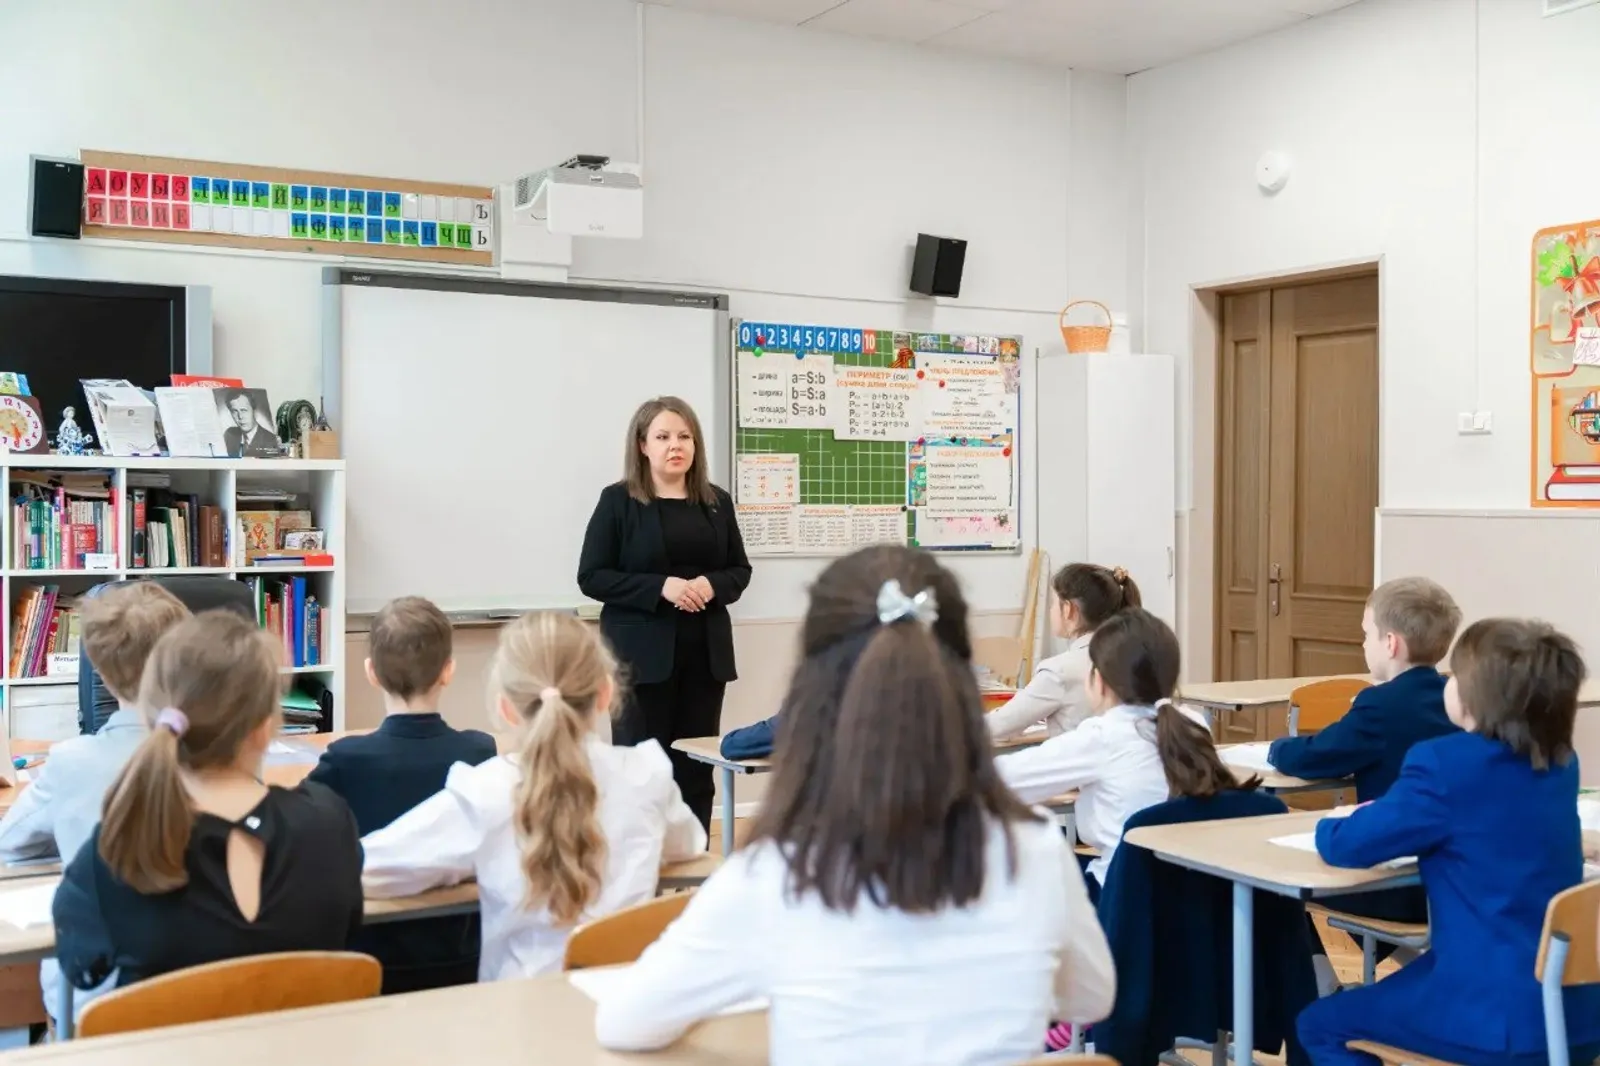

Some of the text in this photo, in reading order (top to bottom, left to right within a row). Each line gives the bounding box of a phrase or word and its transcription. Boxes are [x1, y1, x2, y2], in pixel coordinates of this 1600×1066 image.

[90, 175, 104, 193] А
[111, 176, 124, 192] О
[133, 177, 146, 193] У
[152, 178, 168, 195] Ы
[175, 180, 186, 196] Э
[214, 183, 229, 200] М
[235, 184, 248, 201] Н
[255, 186, 265, 203] Р
[314, 192, 325, 207] В
[349, 196, 362, 212] Д
[476, 204, 488, 220] Ъ
[92, 204, 103, 218] Я
[132, 206, 148, 221] Ю
[154, 206, 168, 222] И
[177, 208, 187, 224] Е
[294, 218, 306, 234] П
[312, 219, 326, 235] Ф
[332, 220, 343, 236] К
[351, 221, 361, 237] Т
[440, 227, 452, 242] Ч
[457, 226, 471, 245] Щ
[478, 231, 487, 245] Ь
[742, 327, 750, 344] 0
[767, 328, 775, 345] 2
[780, 328, 788, 345] 3
[792, 329, 801, 346] 4
[805, 330, 812, 347] 5
[817, 331, 825, 347] 6
[829, 331, 837, 348] 7
[841, 332, 849, 349] 8
[853, 333, 861, 349] 9
[864, 333, 876, 350] 10
[4, 398, 13, 406] 12
